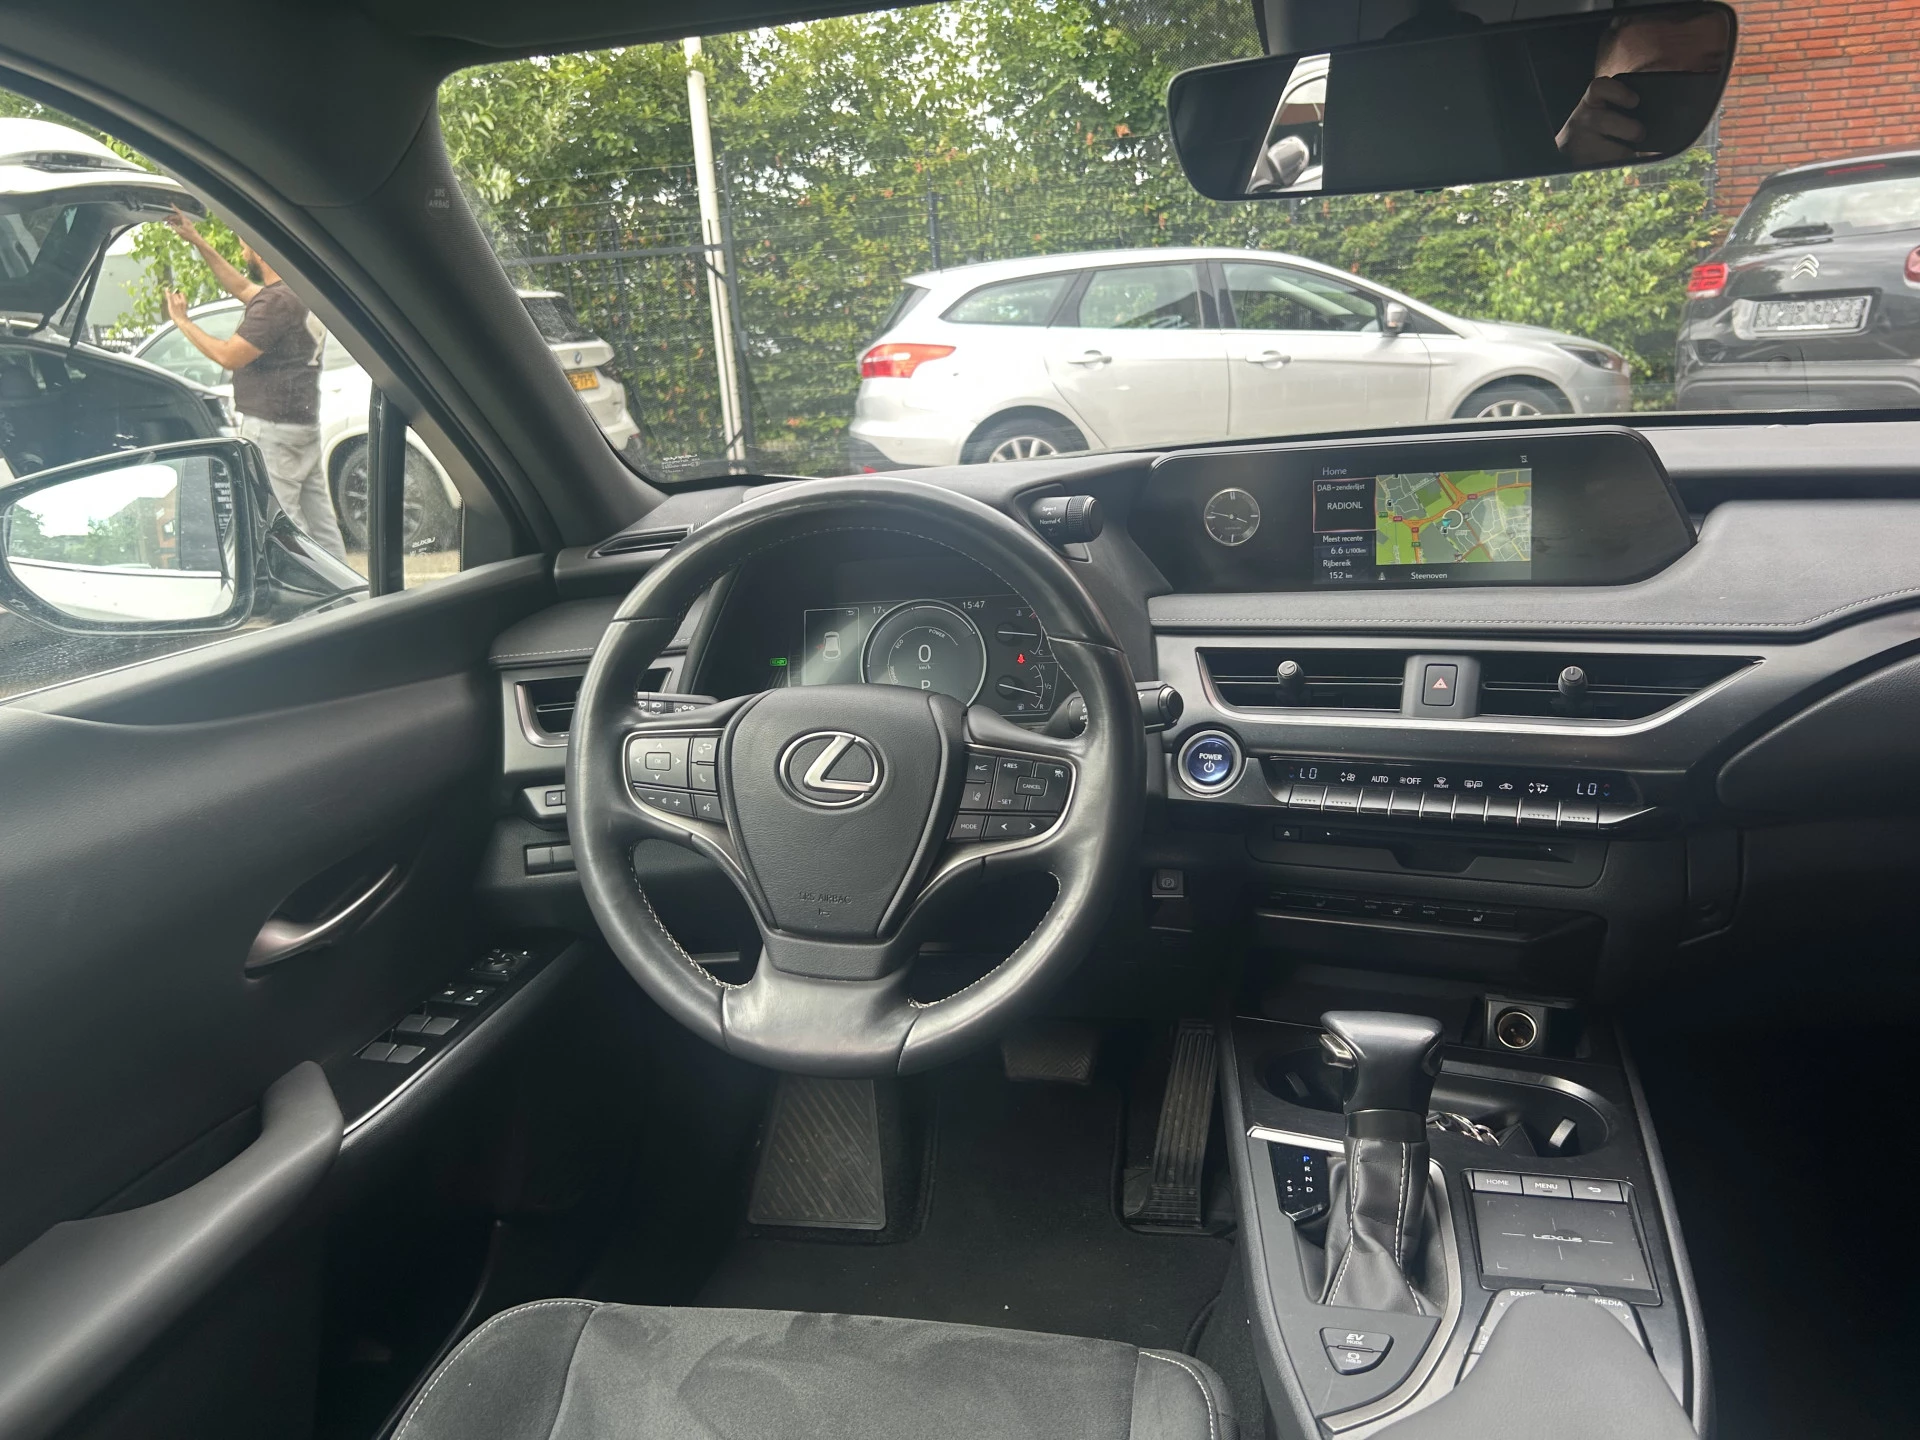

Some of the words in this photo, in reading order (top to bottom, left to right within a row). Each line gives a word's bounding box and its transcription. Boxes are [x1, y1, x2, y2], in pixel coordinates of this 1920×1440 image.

[1322, 467, 1347, 476] Home
[1327, 501, 1364, 511] RADIONL
[1330, 547, 1344, 555] 6.6
[1322, 559, 1352, 569] Rijbereik
[1329, 571, 1344, 579] 152
[1410, 571, 1448, 580] Steenoven
[962, 600, 986, 609] 15:47
[918, 644, 932, 663] 0
[921, 680, 931, 690] P
[1198, 752, 1223, 761] POWER
[1371, 775, 1389, 784] AUTO
[1406, 777, 1422, 785] OFF
[818, 893, 853, 905] AIRBAG
[1486, 1178, 1510, 1186] HOME
[1534, 1182, 1558, 1190] MENU
[1532, 1233, 1583, 1243] LEXUS
[1594, 1298, 1624, 1307] MEDIA
[1346, 1333, 1365, 1341] EV
